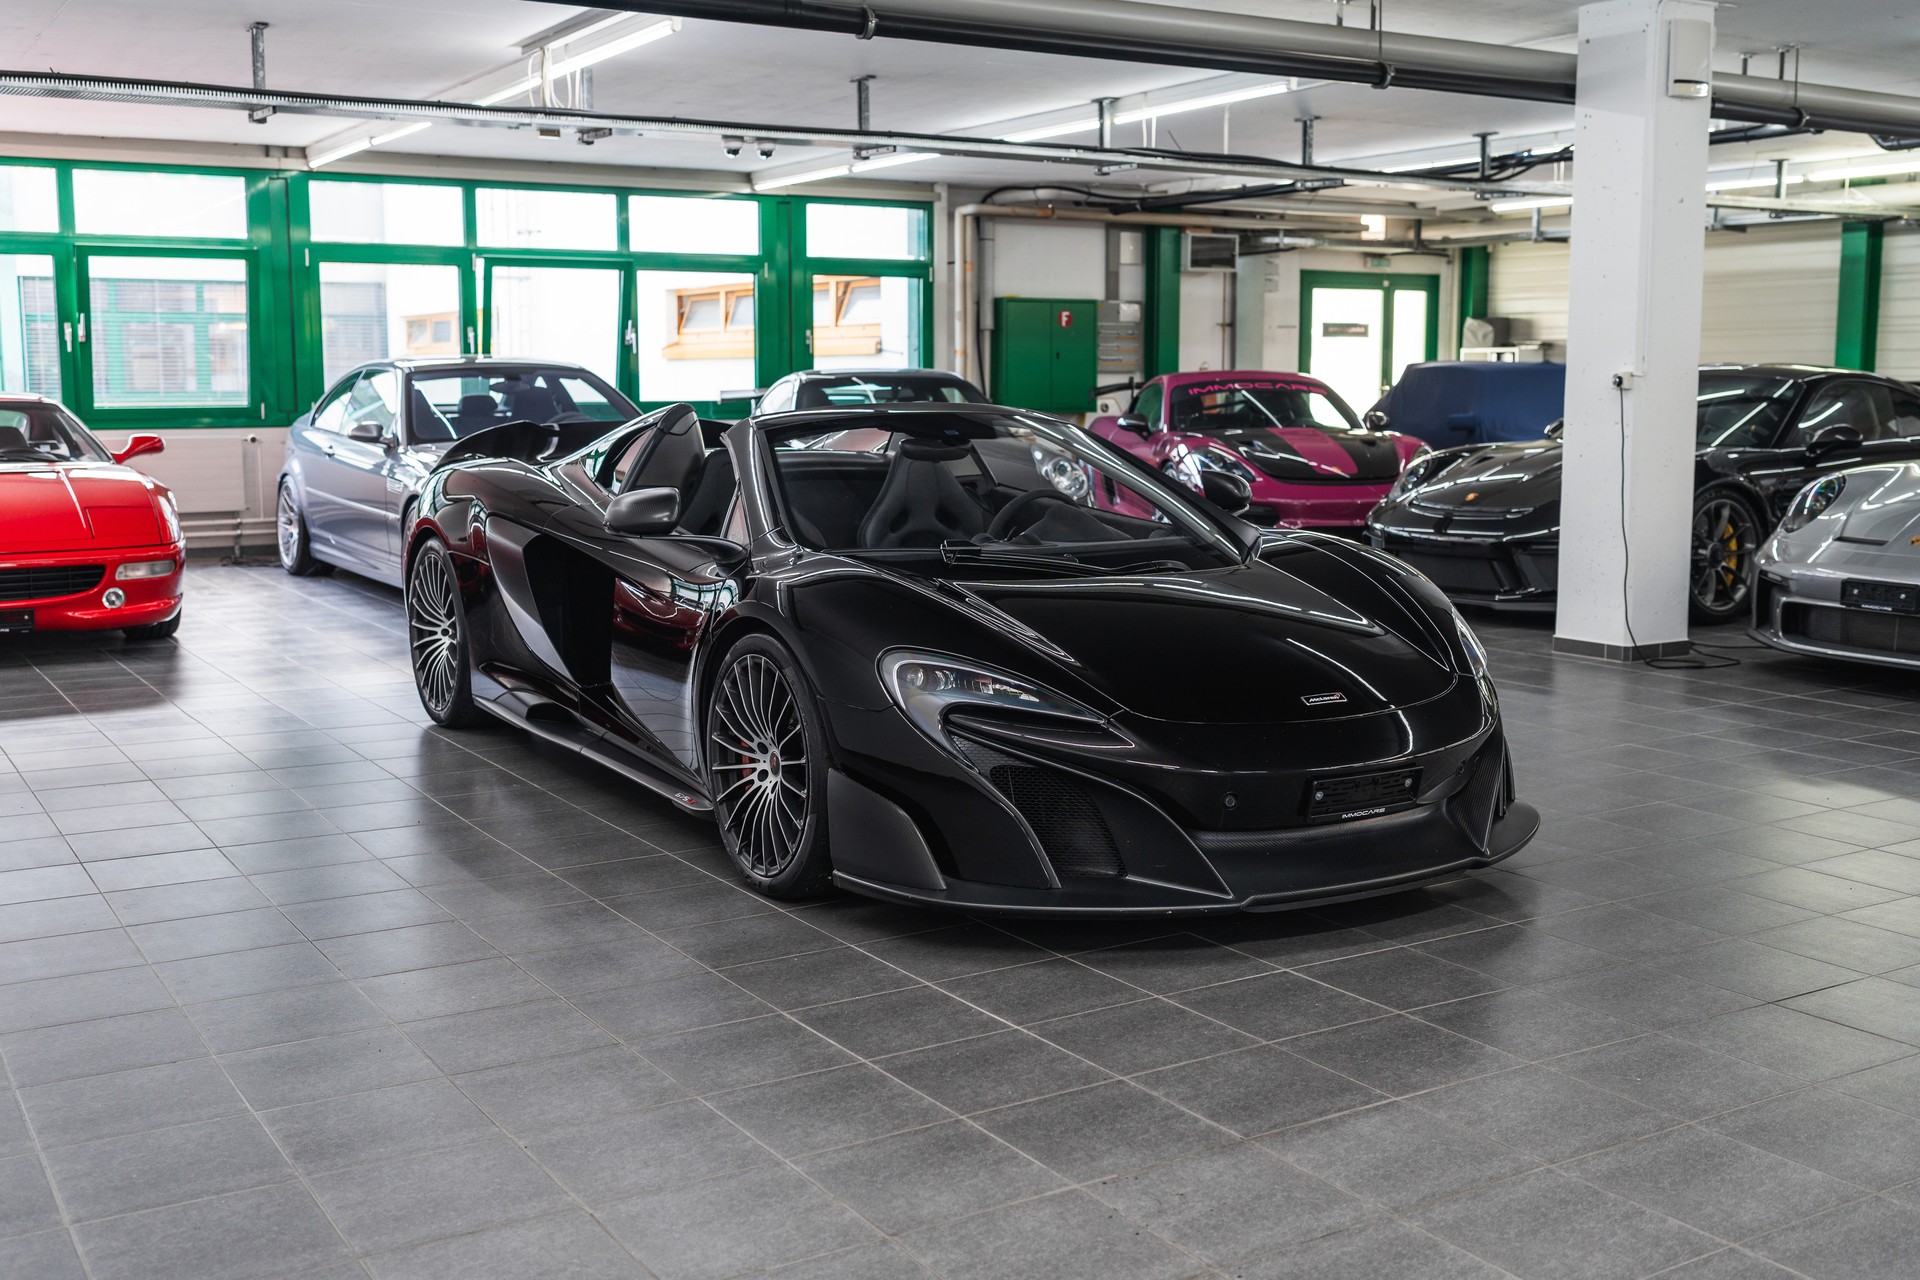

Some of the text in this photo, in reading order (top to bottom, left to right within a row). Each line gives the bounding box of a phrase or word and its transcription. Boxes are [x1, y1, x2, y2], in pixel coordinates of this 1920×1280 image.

[1061, 311, 1070, 327] F
[1188, 382, 1327, 395] IMMOCARS
[1341, 807, 1386, 819] IMMOCARS
